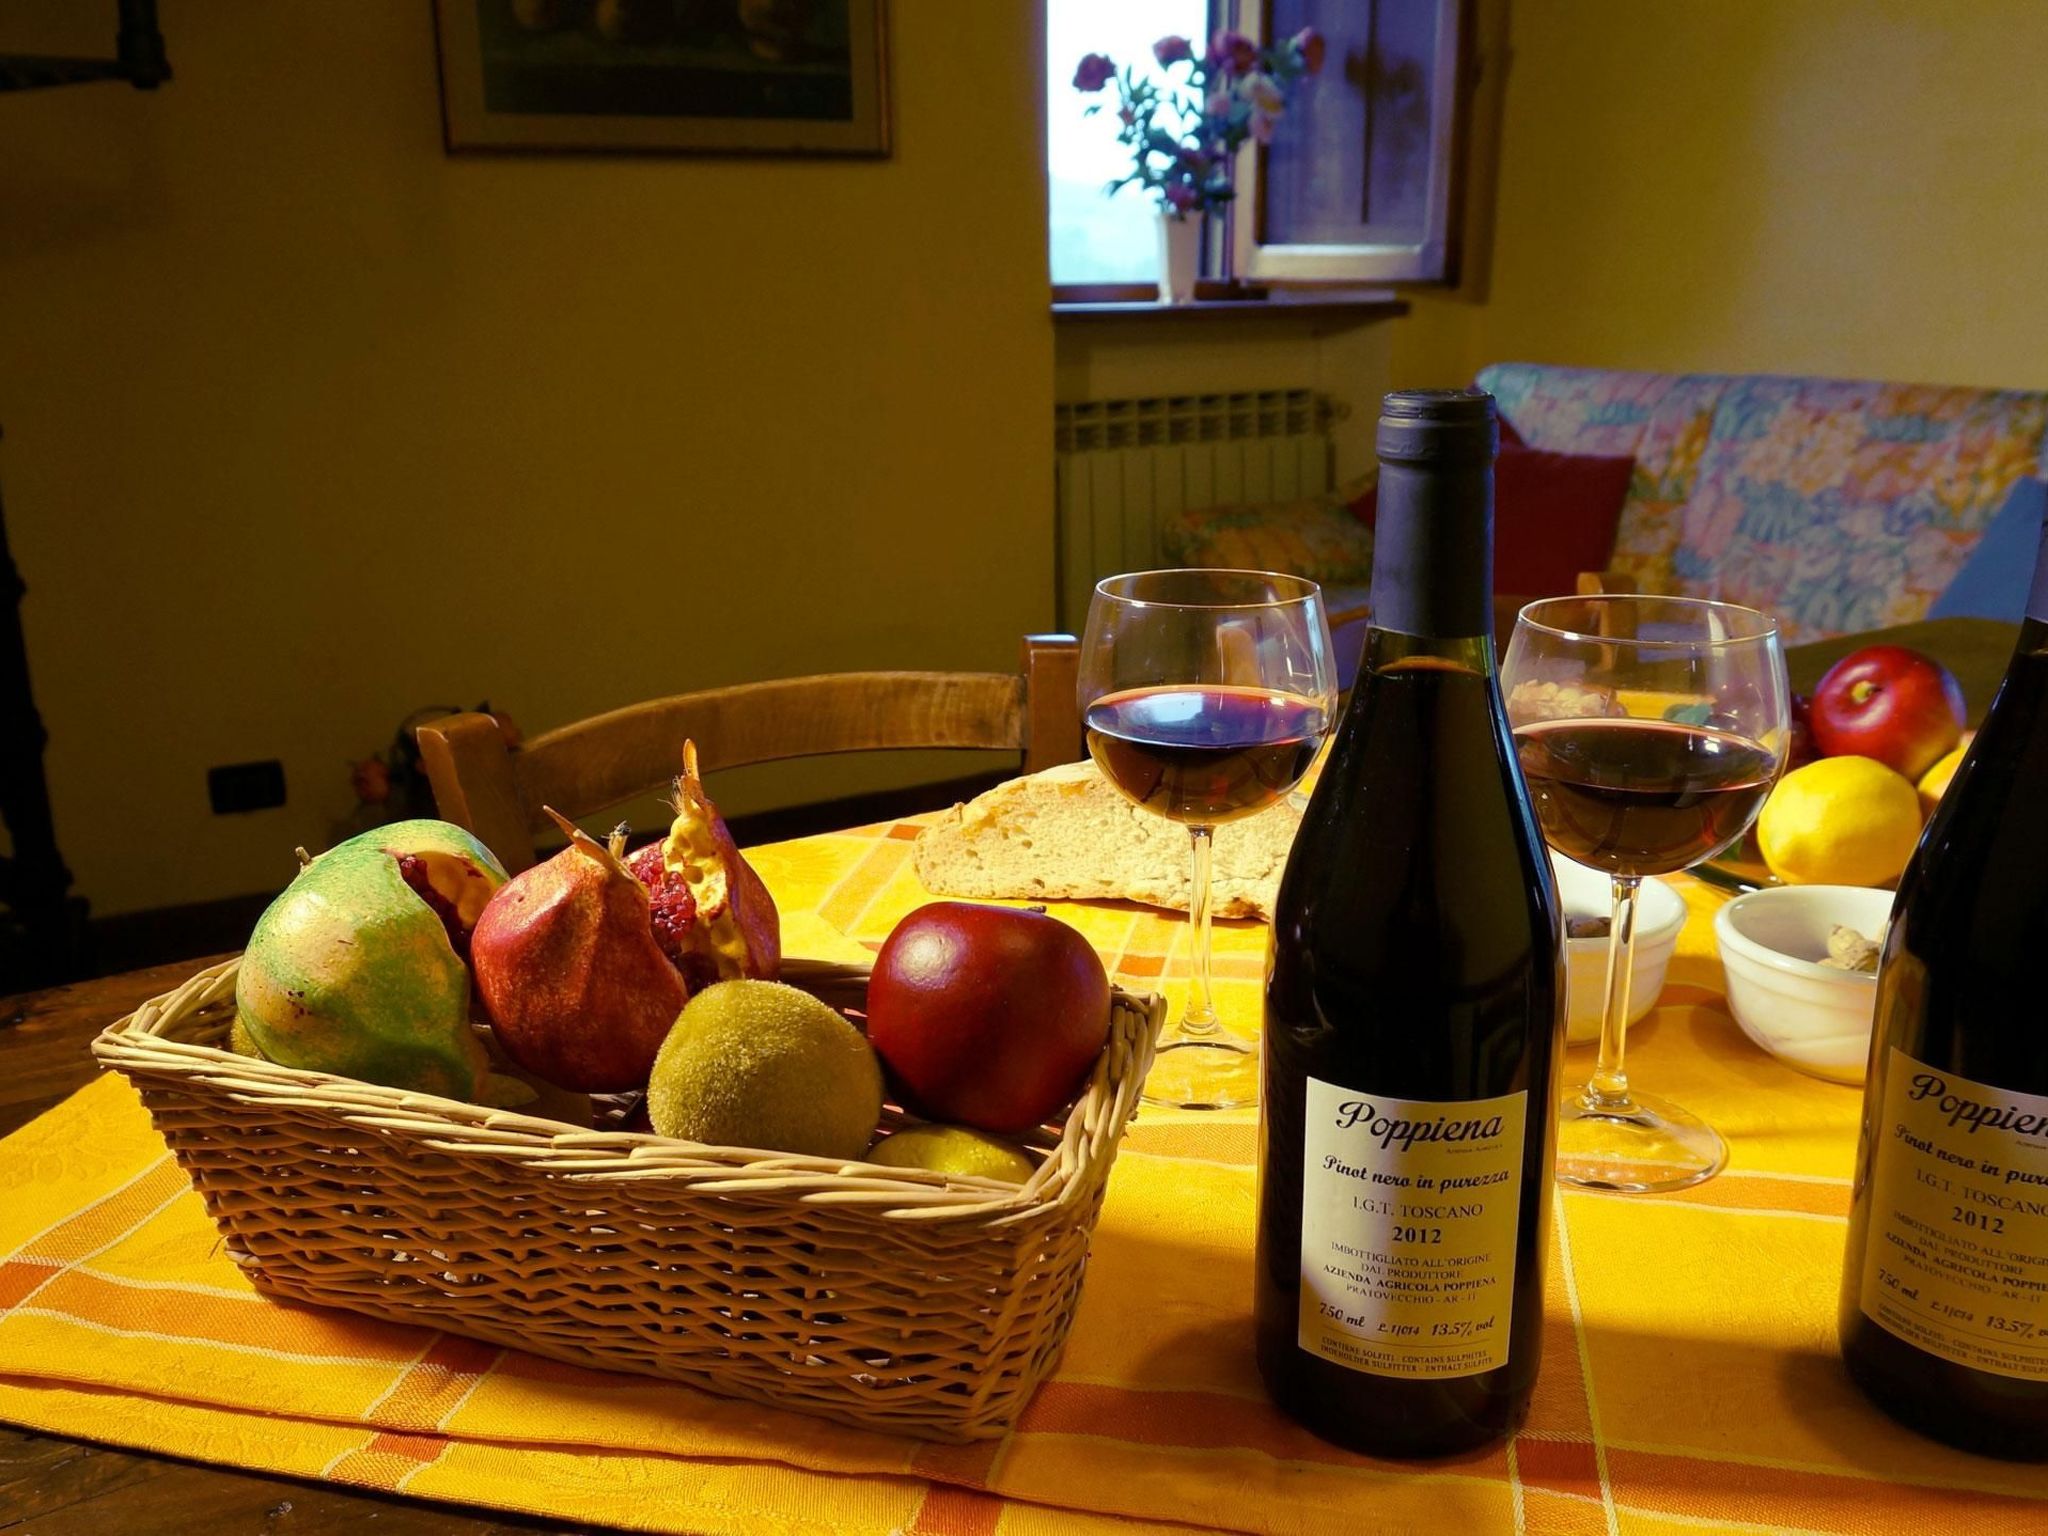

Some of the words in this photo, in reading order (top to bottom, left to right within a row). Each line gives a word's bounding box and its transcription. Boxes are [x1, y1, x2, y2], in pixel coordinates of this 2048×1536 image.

[1335, 1101, 1504, 1152] Poppiena
[1895, 1124, 1934, 1153] Pinot
[1937, 1148, 1975, 1170] nero
[1981, 1160, 2000, 1177] in
[1323, 1155, 1367, 1180] Pinot
[1372, 1172, 1410, 1188] nero
[1416, 1174, 1435, 1189] in
[1440, 1169, 1509, 1194] purezza
[1353, 1196, 1394, 1216] I.G.T.
[1401, 1203, 1484, 1219] TOSCANO
[1952, 1206, 2004, 1234] 2012
[1392, 1226, 1441, 1244] 2012
[1331, 1241, 1419, 1266] IMBOTTIGLIATO
[1323, 1264, 1371, 1285] AZIENDA
[1377, 1279, 1440, 1292] AGRICOLA
[1443, 1277, 1496, 1292] POPPIENA
[1361, 1263, 1384, 1275] DAL
[1388, 1268, 1462, 1279] PRODUTTORE
[1878, 1268, 1900, 1289] 750
[1901, 1287, 1919, 1301] ml
[1320, 1302, 1344, 1320] 750
[1346, 1315, 1367, 1328] ml
[1431, 1320, 1473, 1338] 13.5%
[1475, 1315, 1496, 1332] vol
